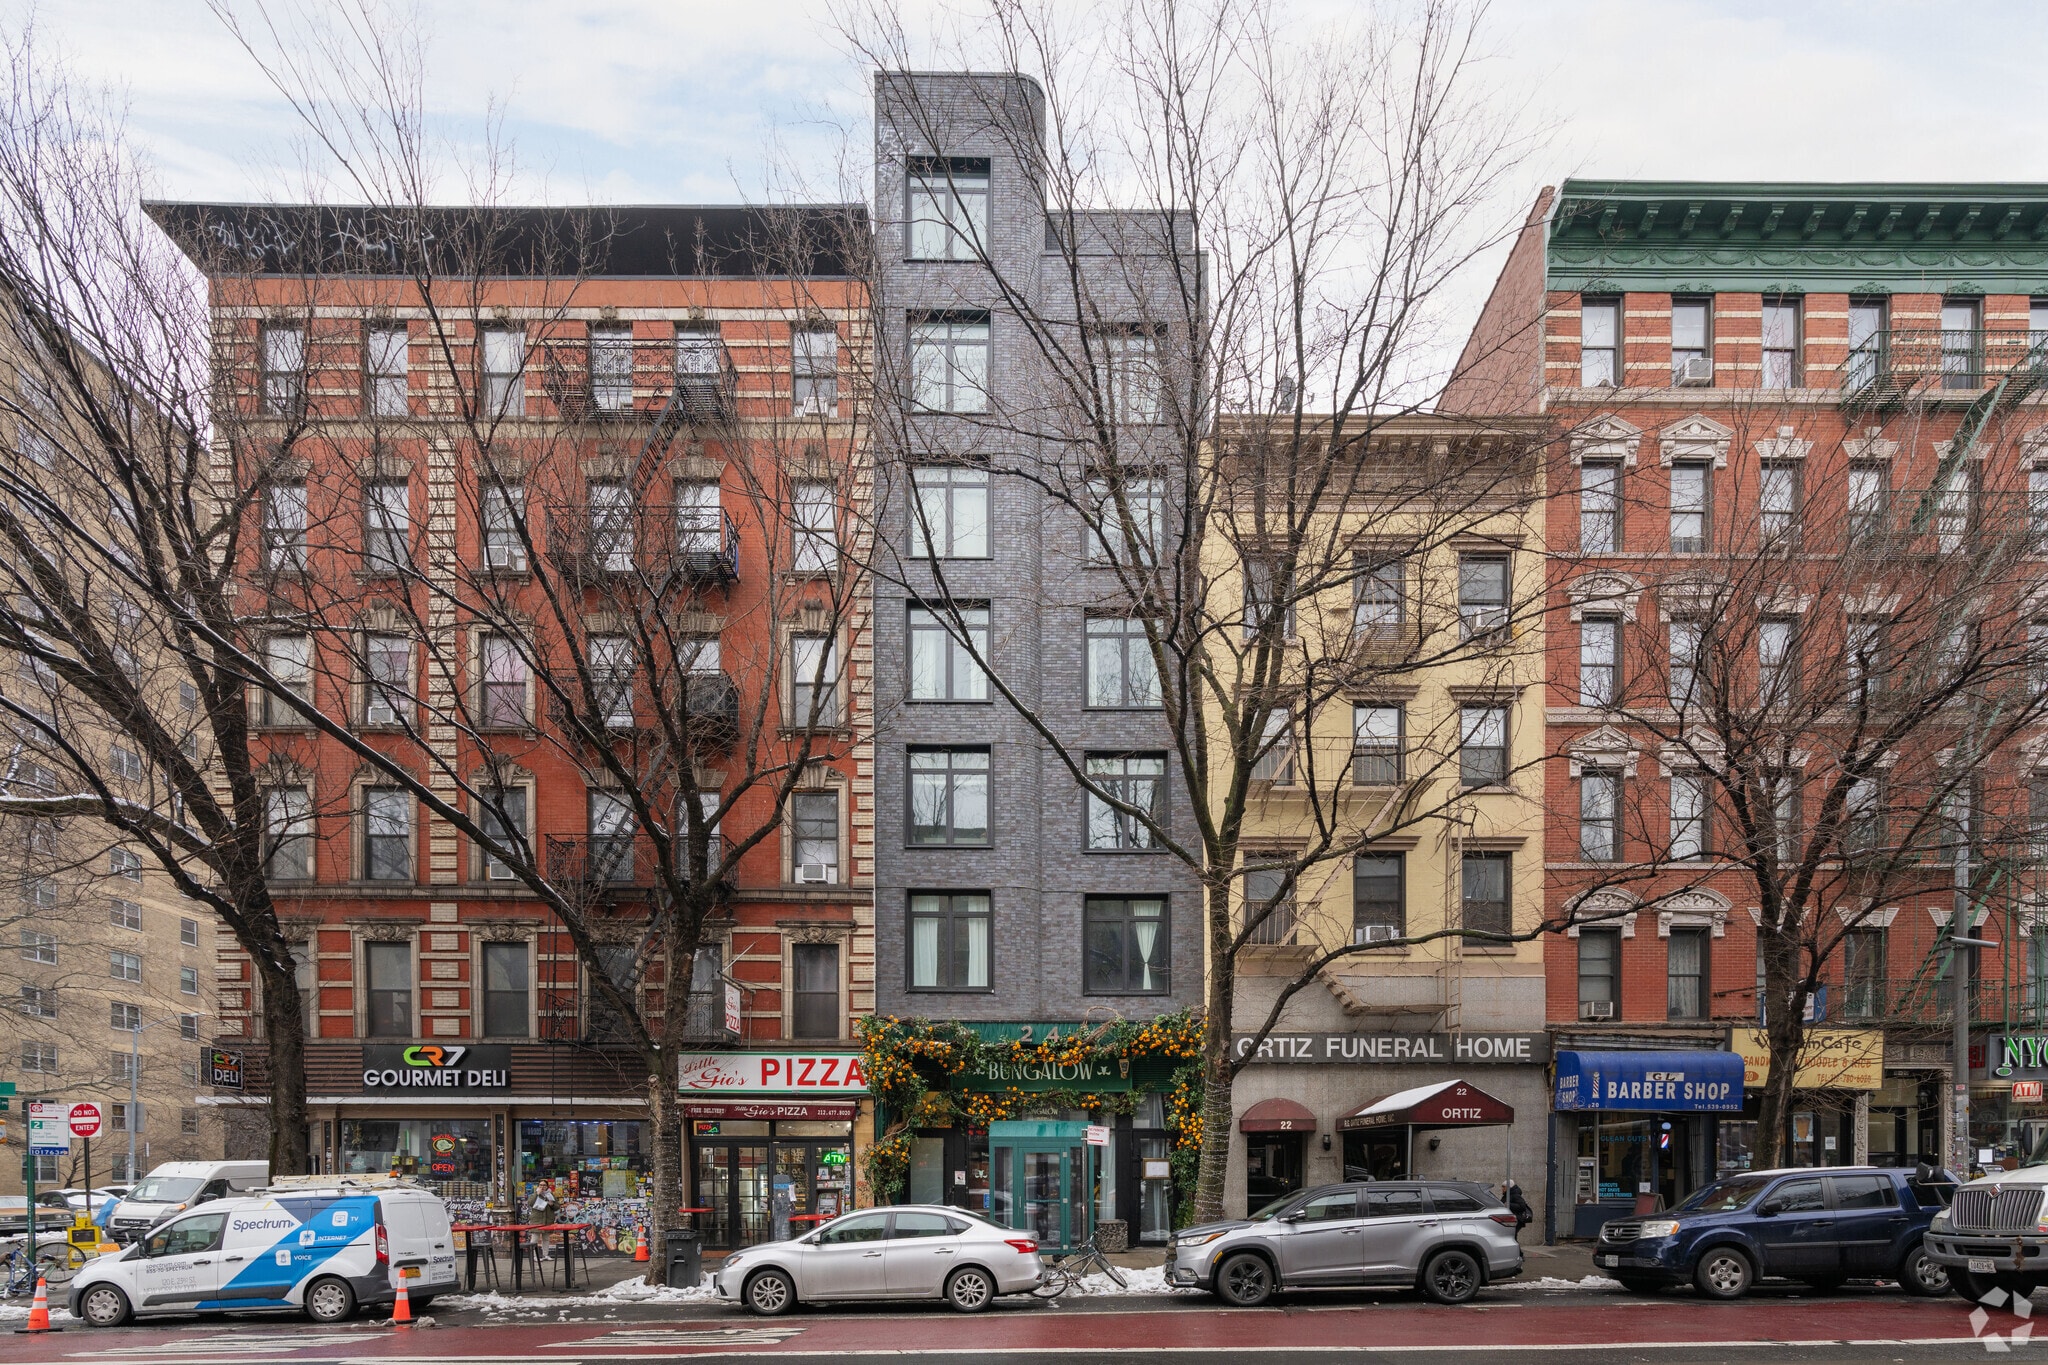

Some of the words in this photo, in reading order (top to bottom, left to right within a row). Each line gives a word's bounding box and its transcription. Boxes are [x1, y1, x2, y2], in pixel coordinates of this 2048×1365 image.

[1237, 1037, 1313, 1058] ORTIZ
[1326, 1037, 1443, 1058] FUNERAL
[1456, 1037, 1531, 1058] HOME
[2001, 1036, 2048, 1068] NY
[403, 1046, 466, 1066] CR7
[1804, 1056, 1838, 1068] NOODLE
[683, 1055, 719, 1075] Little
[760, 1058, 867, 1087] PIZZA
[988, 1061, 1094, 1081] BUNGALOW
[214, 1068, 239, 1083] DELI
[363, 1069, 461, 1088] GOURMET
[467, 1070, 506, 1087] DELI
[687, 1067, 750, 1090] Gio's
[1559, 1074, 1579, 1089] BARBER
[1456, 1088, 1467, 1096] 22
[1562, 1090, 1576, 1103] SHOP
[1607, 1081, 1676, 1099] BARBER
[1684, 1082, 1730, 1100] SHOP
[2014, 1083, 2040, 1096] ATM
[777, 1107, 808, 1116] PIZZA
[1442, 1108, 1482, 1119] ORTIZ
[33, 1121, 41, 1129] 2
[1280, 1120, 1292, 1130] 22
[823, 1152, 846, 1164] ATM
[431, 1163, 455, 1172] OPEN
[232, 1218, 291, 1233] Spectrum
